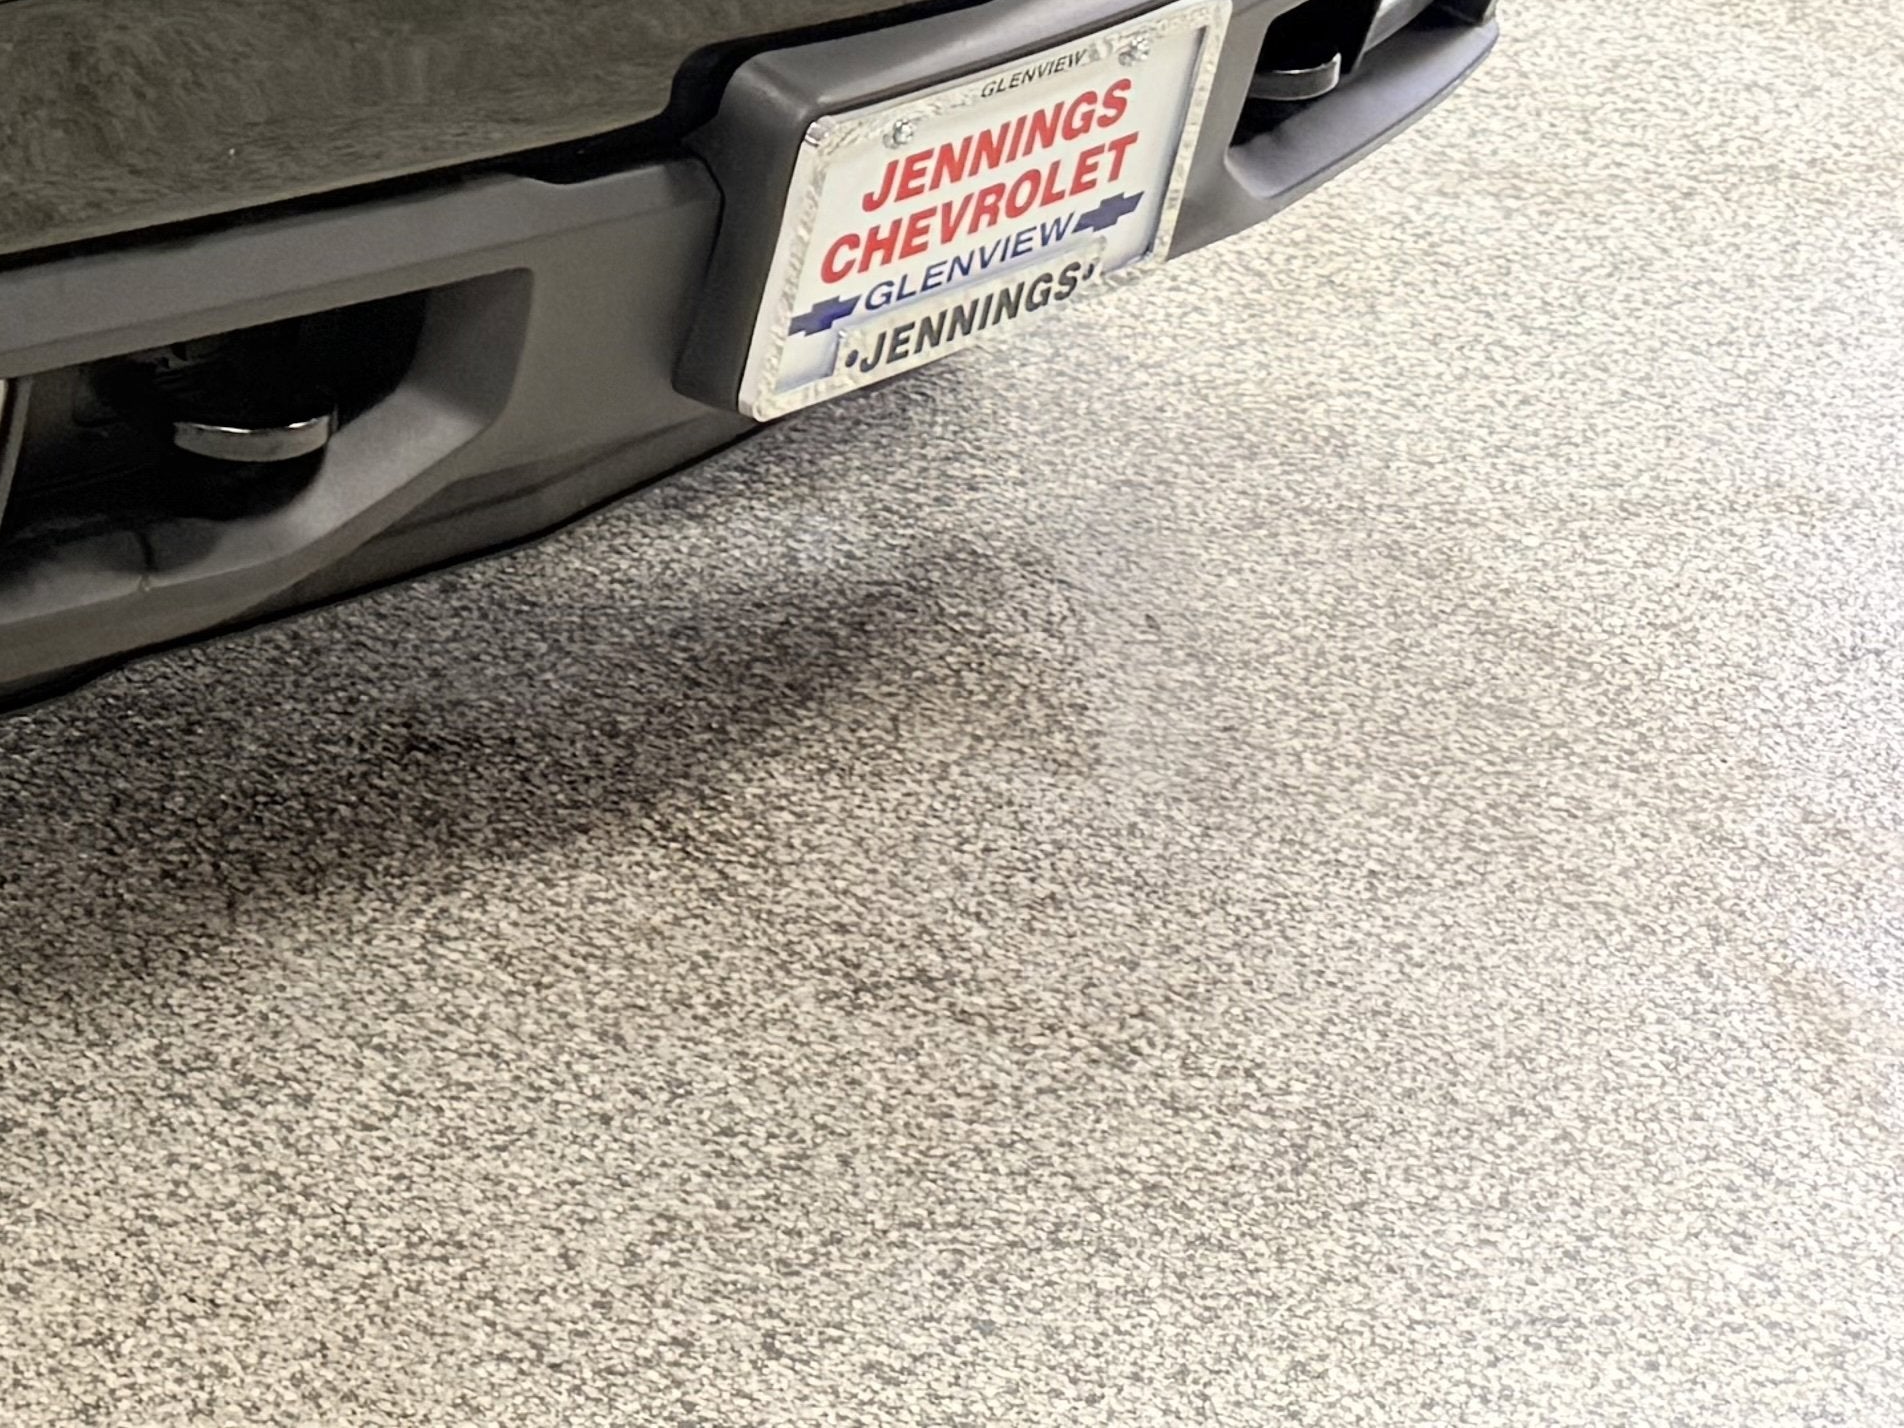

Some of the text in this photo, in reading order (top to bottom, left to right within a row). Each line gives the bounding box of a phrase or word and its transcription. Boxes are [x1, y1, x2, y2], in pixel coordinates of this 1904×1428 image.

[819, 131, 1140, 284] CHEVROLET
[862, 77, 1133, 213] JENNINGS
[864, 211, 1076, 311] GLENVIEW
